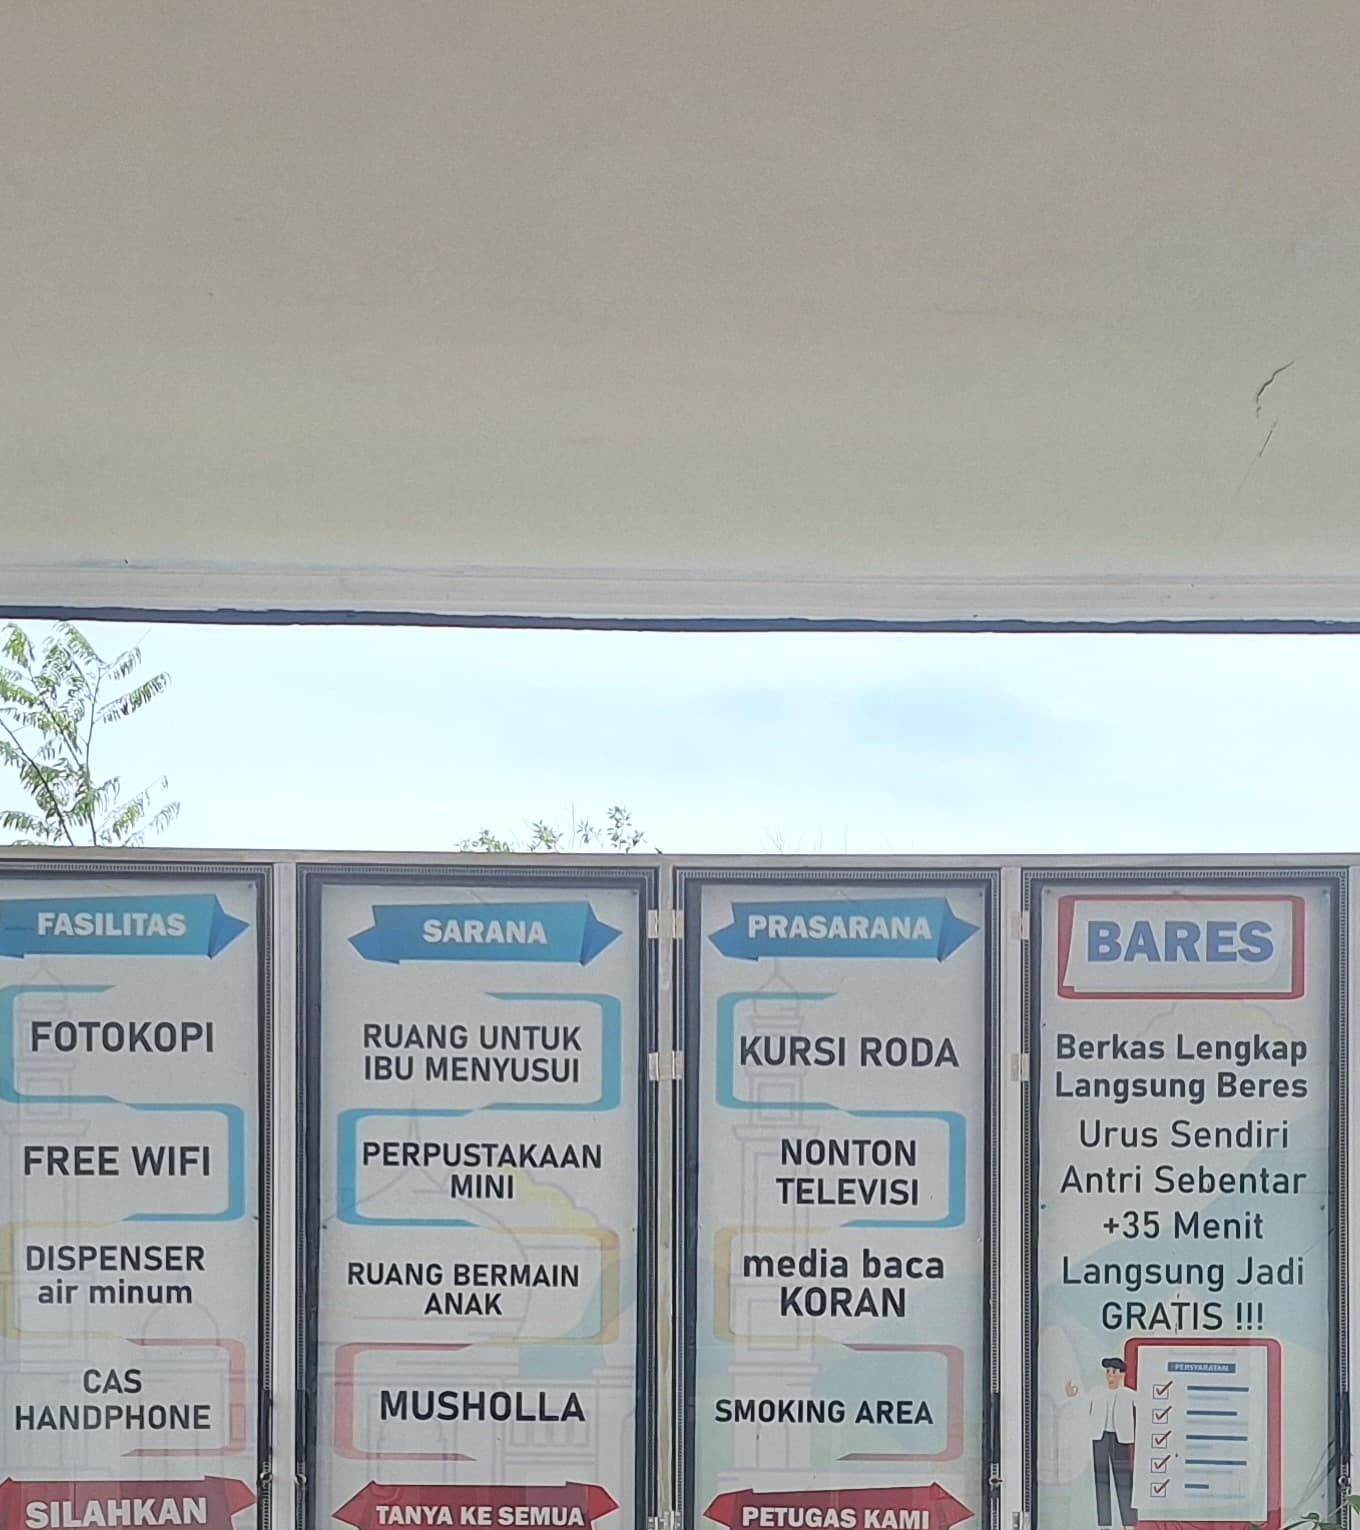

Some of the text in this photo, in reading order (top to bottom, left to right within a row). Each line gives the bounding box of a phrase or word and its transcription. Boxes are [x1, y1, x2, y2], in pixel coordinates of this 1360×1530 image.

[37, 912, 187, 937] FASILITAS
[422, 919, 548, 945] SARANA
[748, 915, 932, 940] PRASARANA
[1087, 920, 1275, 963] BARES
[31, 1021, 213, 1053] FOTOKOPI
[363, 1023, 582, 1051] RUANG UNTUK
[740, 1035, 959, 1068] KURSI RODA
[1056, 1033, 1307, 1067] Berkas Lengkap
[364, 1056, 579, 1083] IBU MENYUSUI
[1079, 1119, 1289, 1148] Urus Sendiri
[24, 1146, 210, 1176] FREE WIFI
[362, 1142, 602, 1169] PERPUSTAKAAN
[781, 1138, 917, 1167] NONTON
[450, 1175, 514, 1199] MINI
[776, 1177, 918, 1206] TELEVISI
[1060, 1165, 1307, 1195] Antri Sebentar
[1174, 1211, 1263, 1240] Menit
[26, 1246, 206, 1271] DISPENSER
[743, 1248, 944, 1279] media baca
[1062, 1256, 1304, 1291] Langsung Jadi
[38, 1278, 193, 1304] air minum
[424, 1292, 502, 1315] ANAK
[780, 1286, 906, 1318] KORAN
[1102, 1301, 1224, 1331] GRATIS
[83, 1369, 142, 1395] CAS
[15, 1405, 211, 1430] HANDPHONE
[380, 1390, 586, 1422] MUSHOLLA
[715, 1399, 934, 1425] SMOKING AREA
[25, 1497, 208, 1529] SILAHKAN
[376, 1505, 584, 1527] TANYA KE SEMUA
[742, 1506, 930, 1530] PETUGAS KAMI
